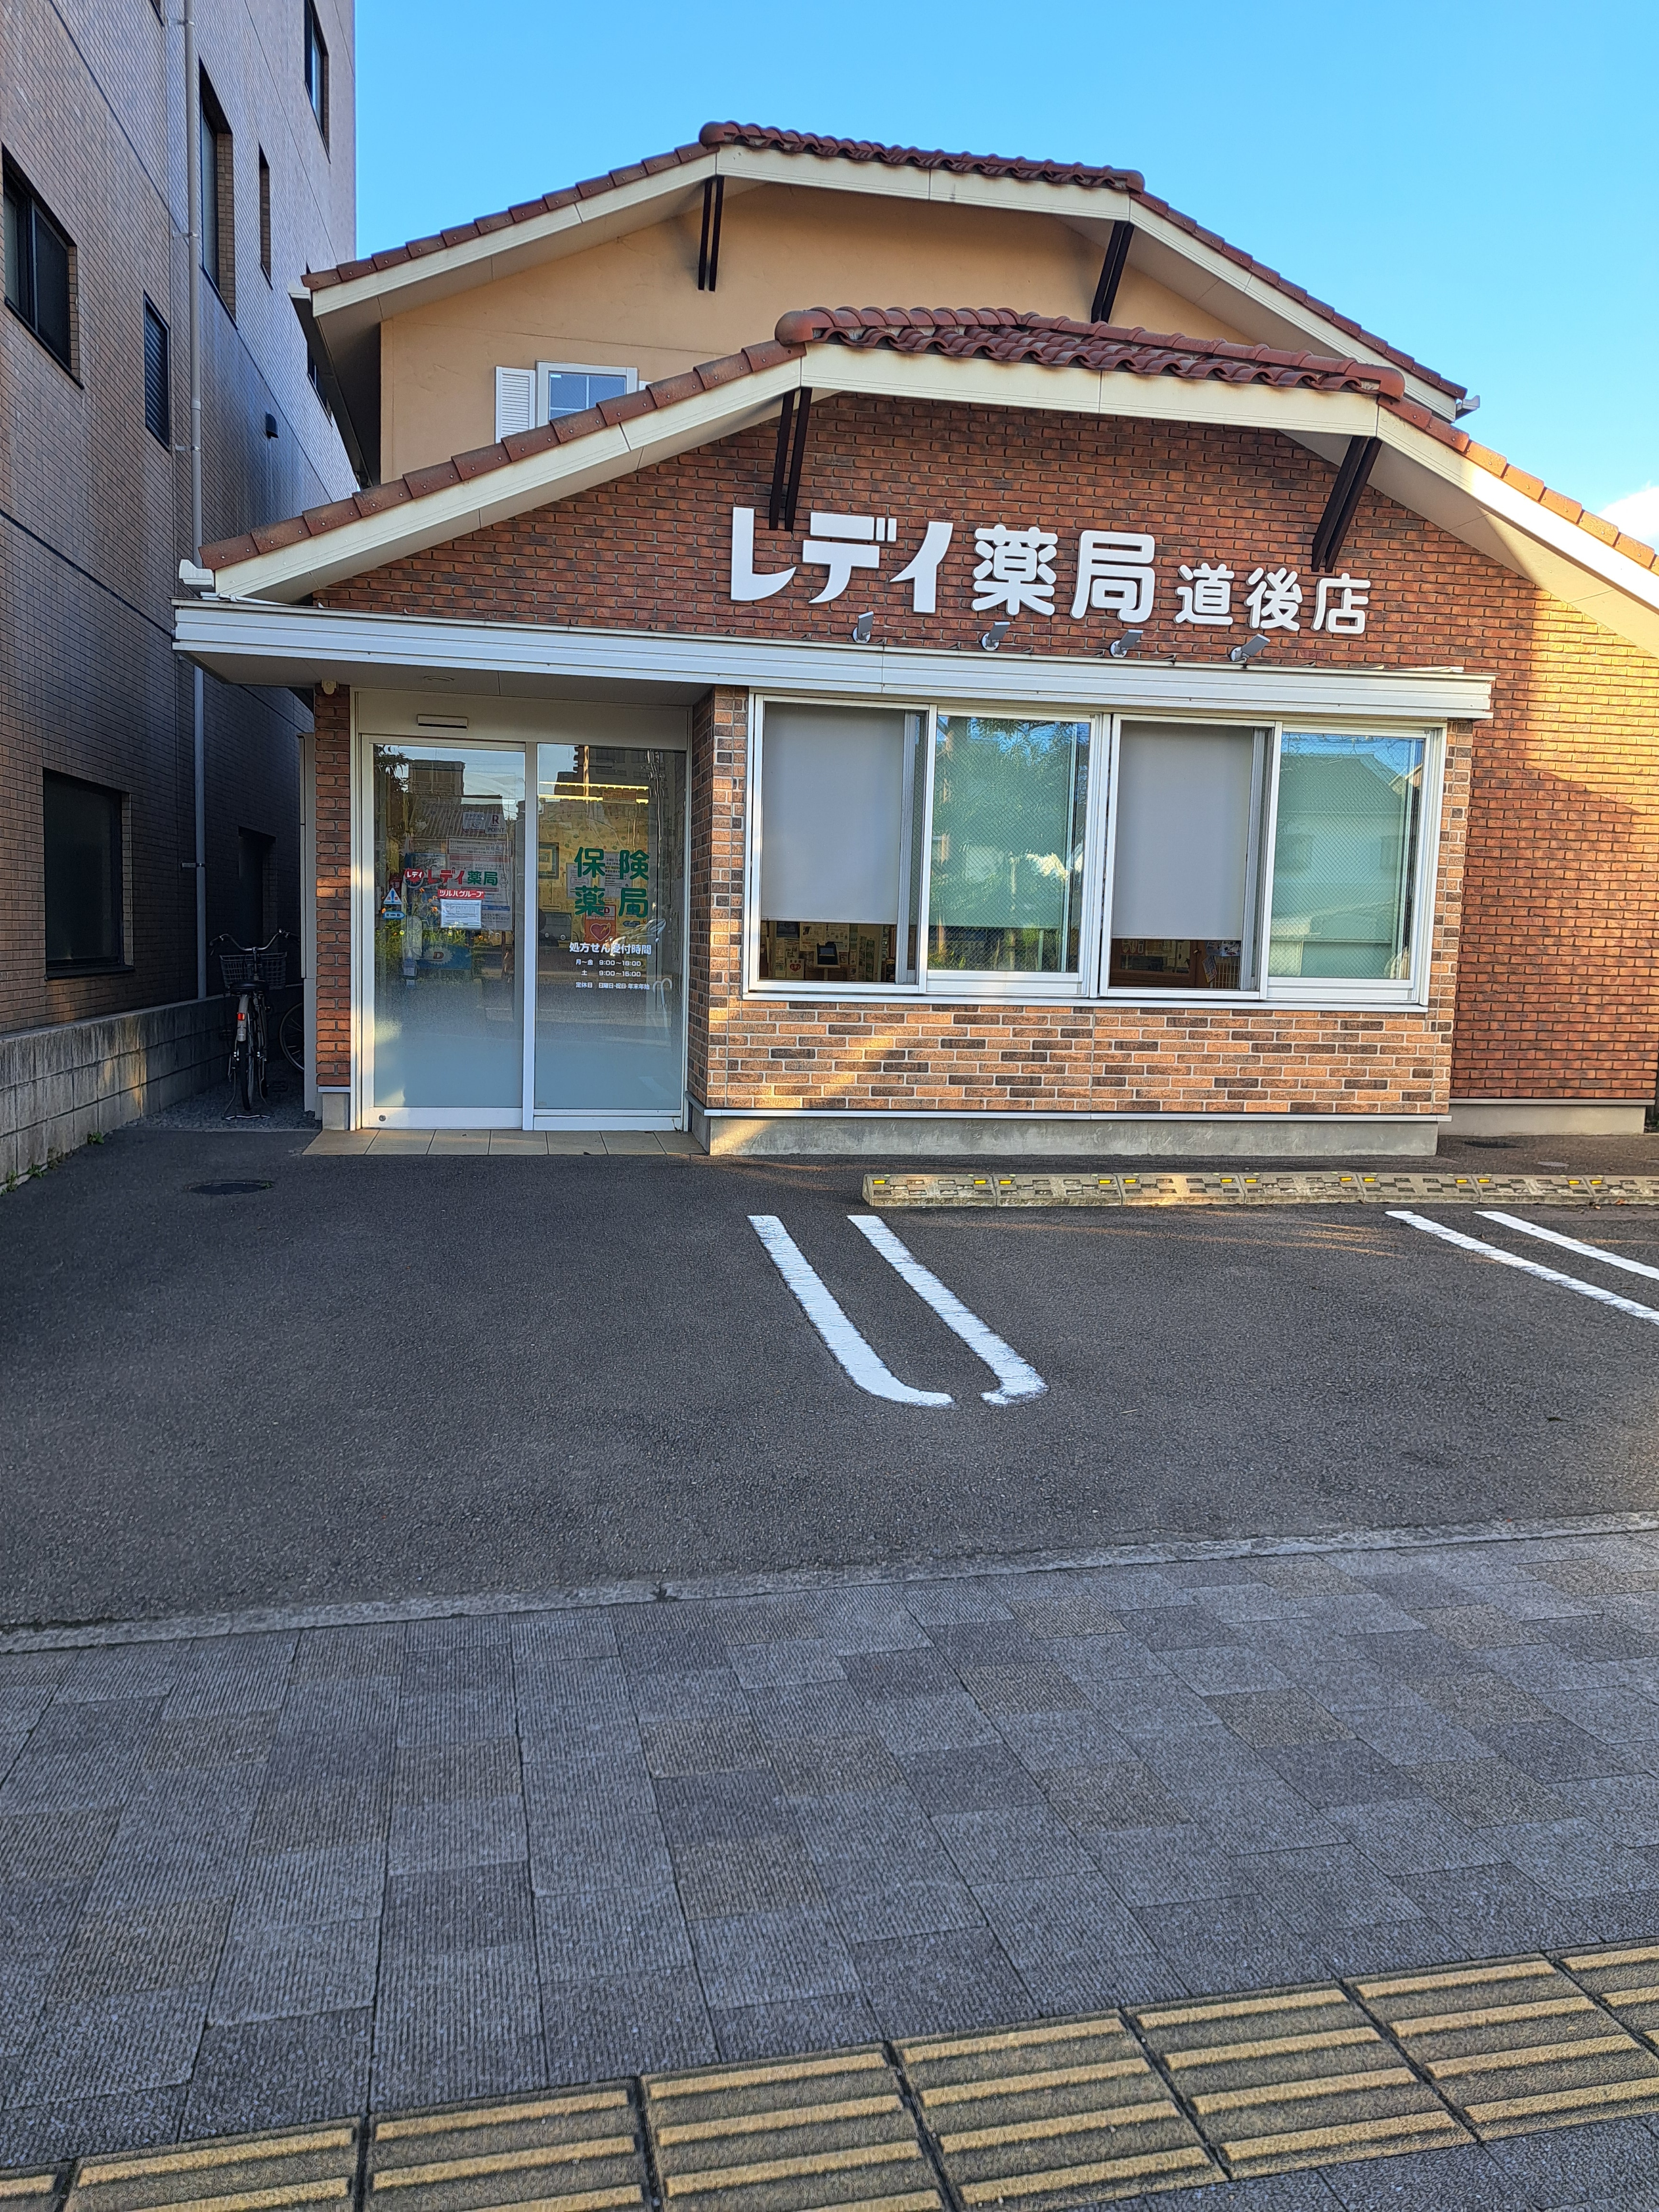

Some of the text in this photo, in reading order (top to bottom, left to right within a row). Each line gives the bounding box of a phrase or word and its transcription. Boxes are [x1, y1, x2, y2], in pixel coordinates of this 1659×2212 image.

[730, 506, 1371, 635] レディ薬局 道後店
[574, 846, 650, 880] 保険
[427, 869, 498, 885] レディ薬局
[439, 890, 484, 898] ツルハグループ
[575, 885, 648, 918] 薬局
[569, 942, 652, 955] 処方せん受付時間
